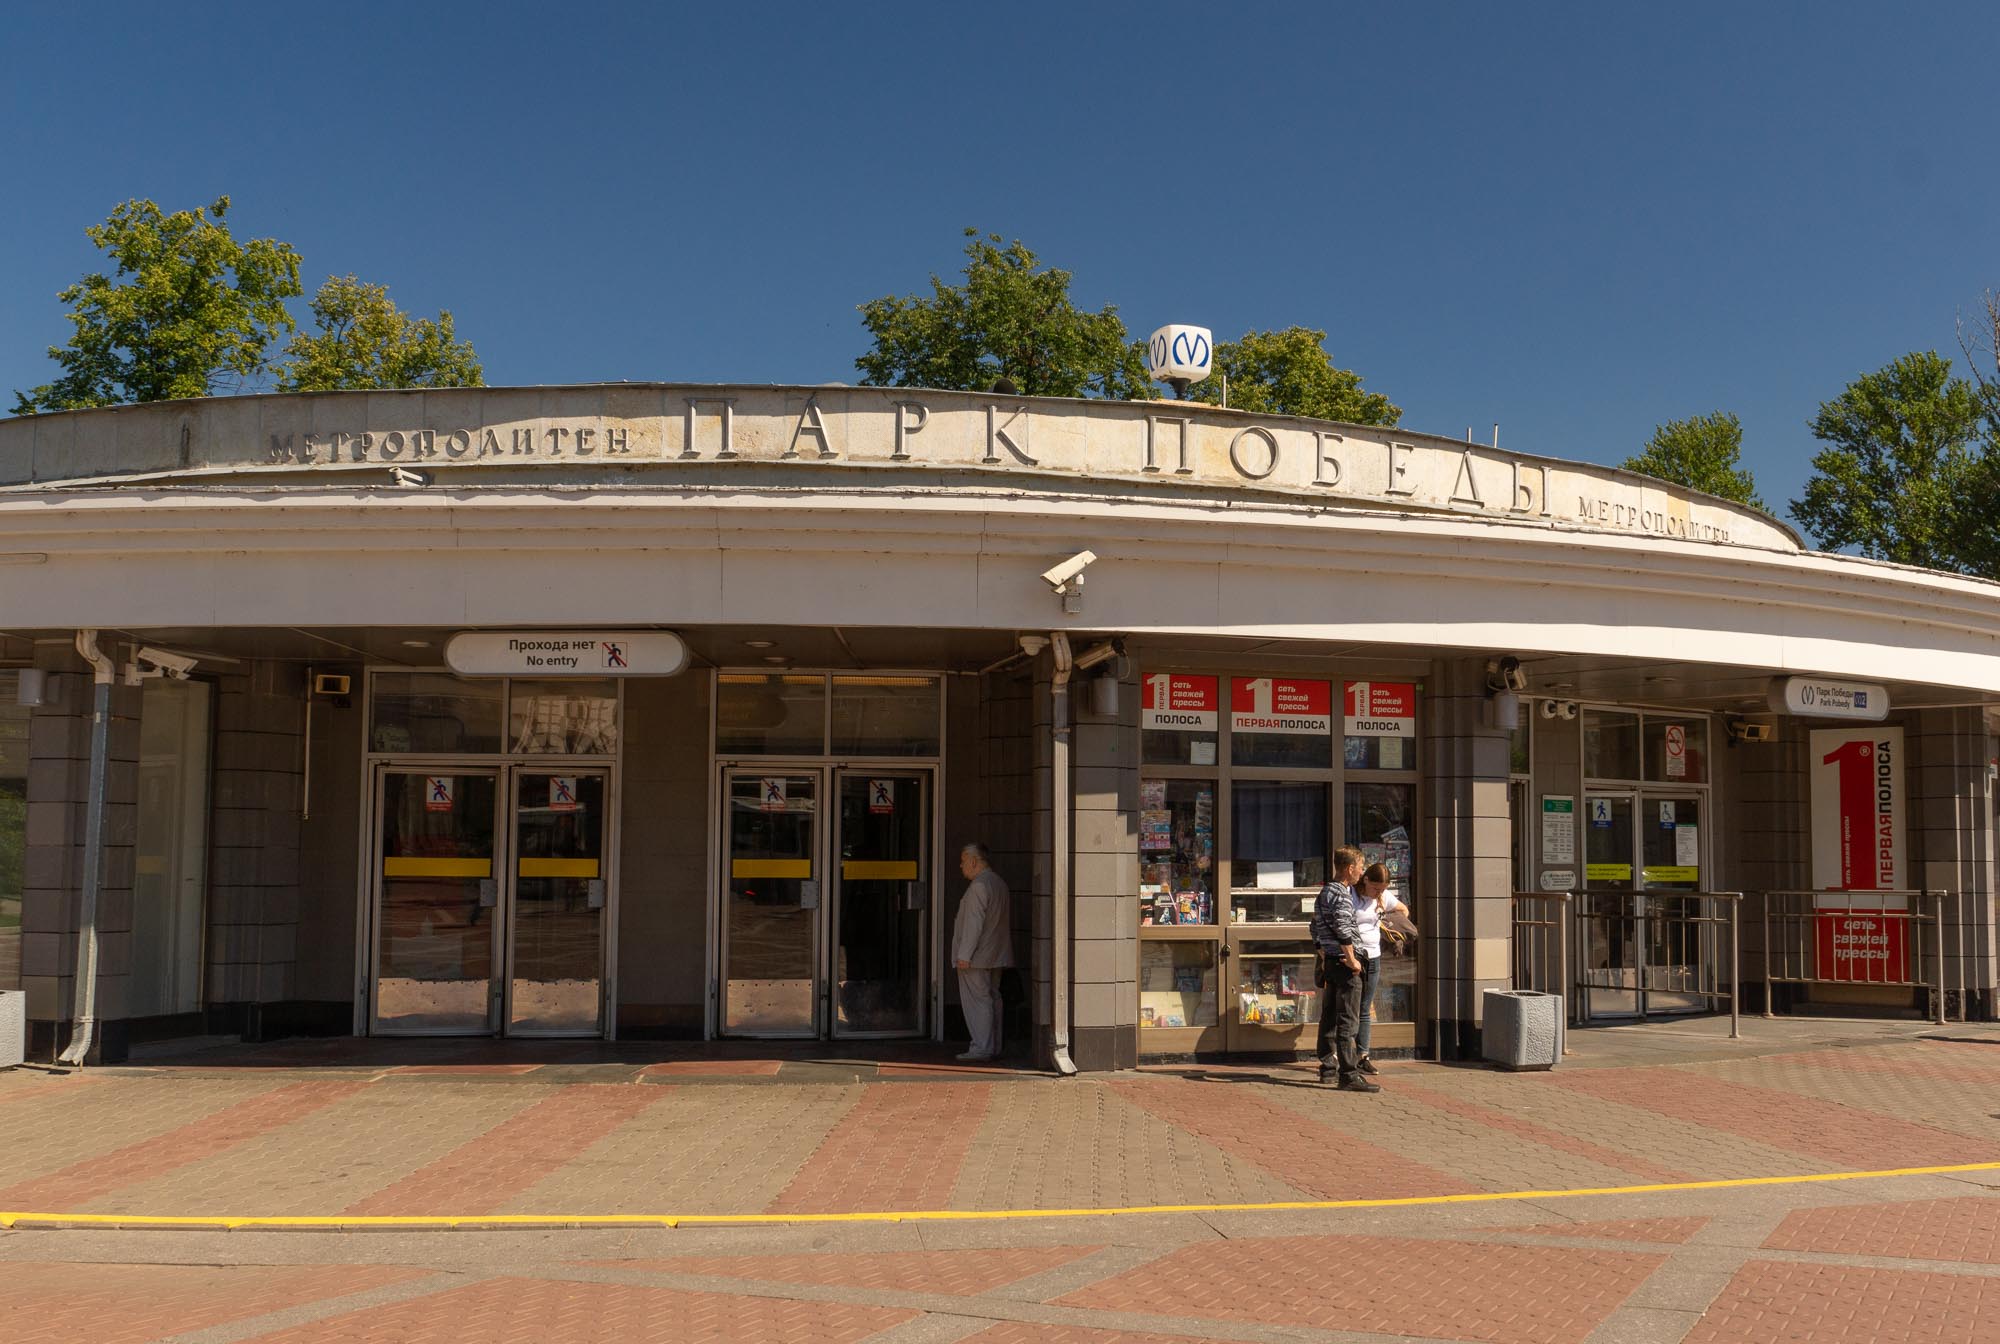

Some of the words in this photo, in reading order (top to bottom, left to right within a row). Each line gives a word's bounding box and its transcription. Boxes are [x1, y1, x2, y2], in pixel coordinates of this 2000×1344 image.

[269, 427, 632, 463] МЕТРОПОЛИТЕН
[681, 393, 1039, 466] ПАРК
[1141, 415, 1553, 518] ПОБЕДЫ
[509, 639, 568, 653] Прохода
[572, 641, 596, 650] нет
[526, 655, 543, 666] No
[546, 656, 578, 669] entry
[1172, 690, 1204, 698] свежей
[1277, 694, 1309, 702] свежей
[1816, 687, 1831, 697] Парк
[1831, 687, 1854, 698] Победы
[1172, 699, 1205, 708] прессы
[1277, 703, 1309, 711] прессы
[1820, 698, 1832, 707] Park
[1372, 706, 1403, 715] прессы
[1155, 714, 1202, 725] ПОЛОСА
[1236, 718, 1326, 730] ПЕРВАЯПОЛОСА
[1356, 721, 1400, 731] ПОЛОСА
[1878, 740, 1894, 884] ПЕРВАЯПОЛОСА
[1843, 920, 1877, 930] сеть
[1833, 934, 1888, 945] свежей
[1833, 948, 1890, 961] прессы
